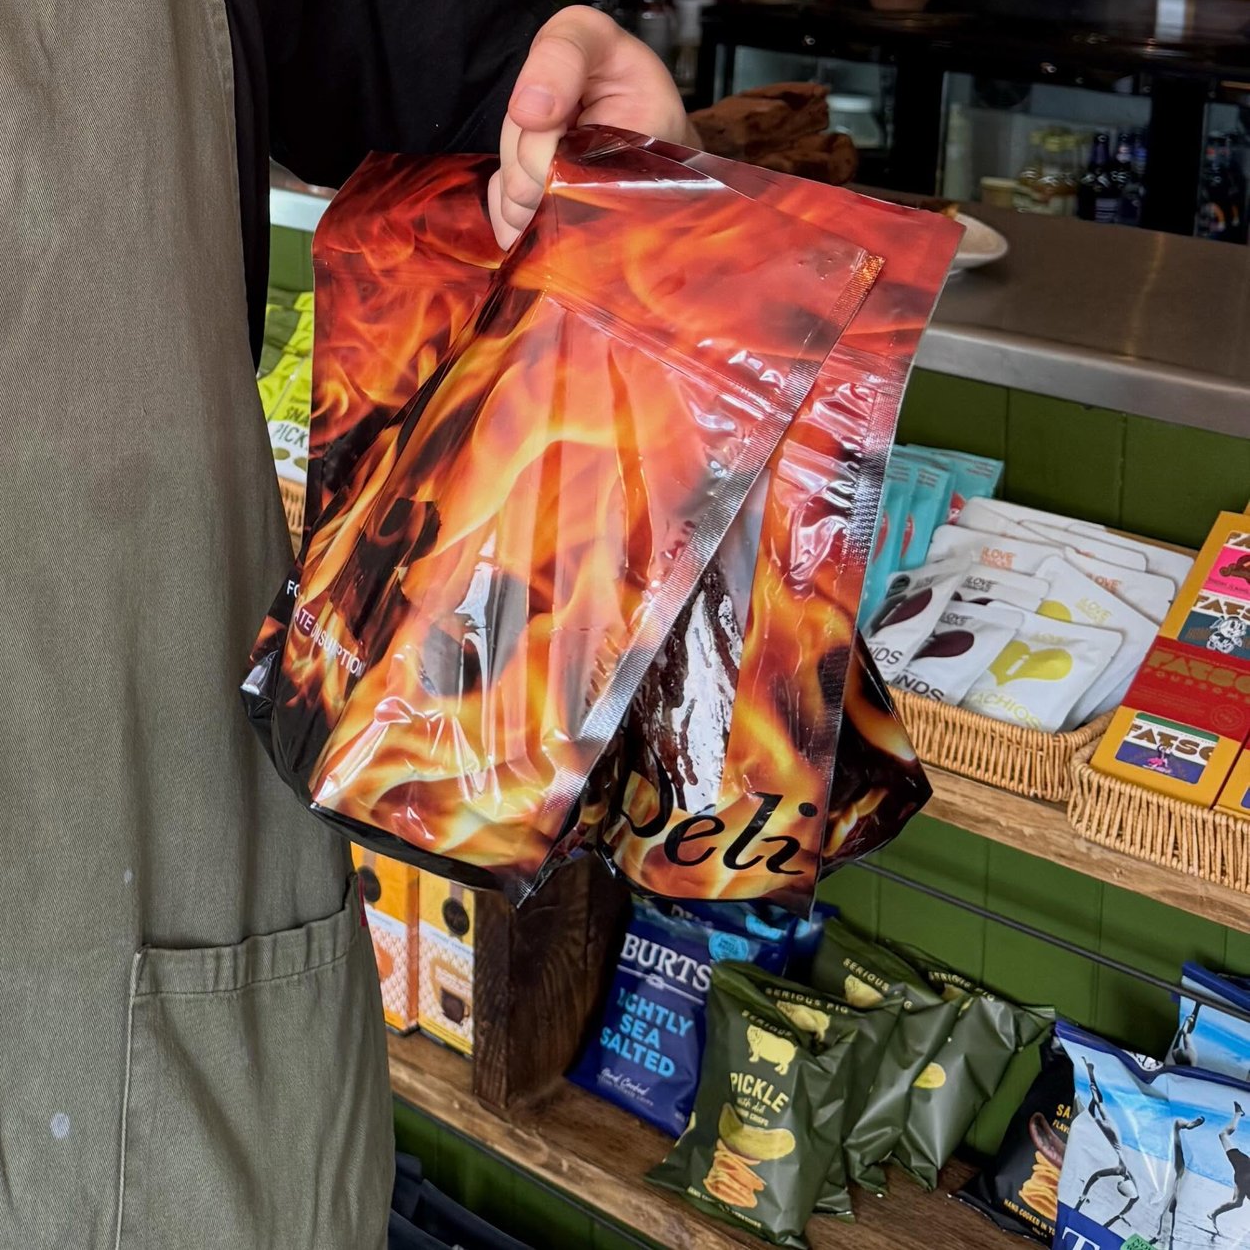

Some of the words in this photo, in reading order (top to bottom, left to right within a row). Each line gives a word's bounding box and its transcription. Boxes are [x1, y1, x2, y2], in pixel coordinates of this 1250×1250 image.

[620, 933, 712, 991] BURTS
[843, 958, 889, 992] SERIOUS
[765, 988, 821, 1008] SERIOUS
[826, 1001, 849, 1014] PIG
[620, 1014, 660, 1048] SEA
[600, 1027, 675, 1078] SALTED
[730, 1073, 789, 1113] PICKLE
[1004, 1198, 1020, 1214] HAND
[1019, 1207, 1041, 1226] COOKED
[1040, 1219, 1050, 1231] IN
